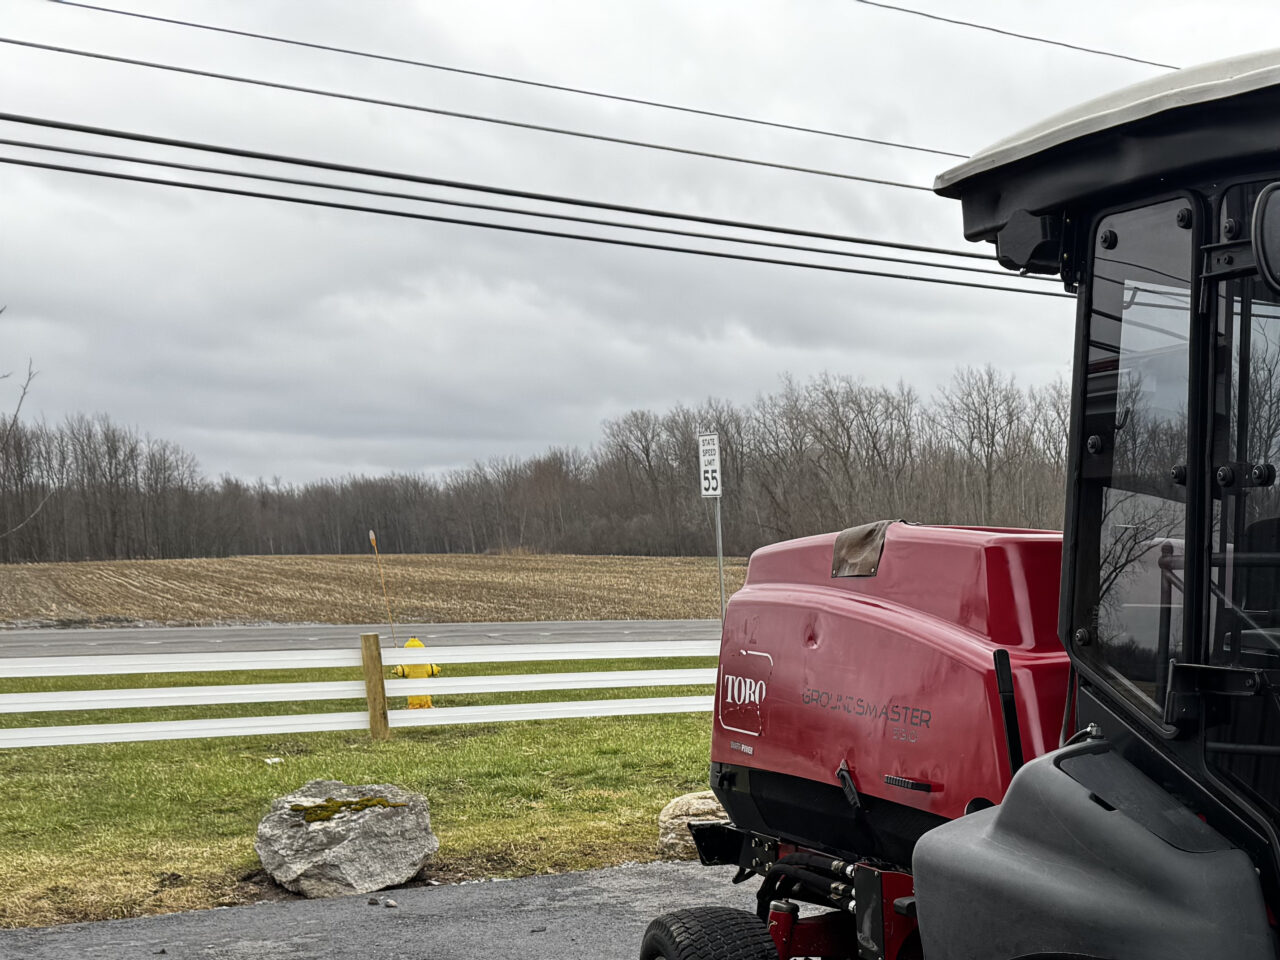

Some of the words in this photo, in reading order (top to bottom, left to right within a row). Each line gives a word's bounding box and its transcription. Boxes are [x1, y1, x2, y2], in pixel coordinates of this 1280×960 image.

[702, 438, 715, 446] STATE
[702, 448, 716, 456] SPEED
[704, 458, 715, 467] LIMIT
[703, 469, 719, 492] 55
[724, 674, 767, 705] TORO
